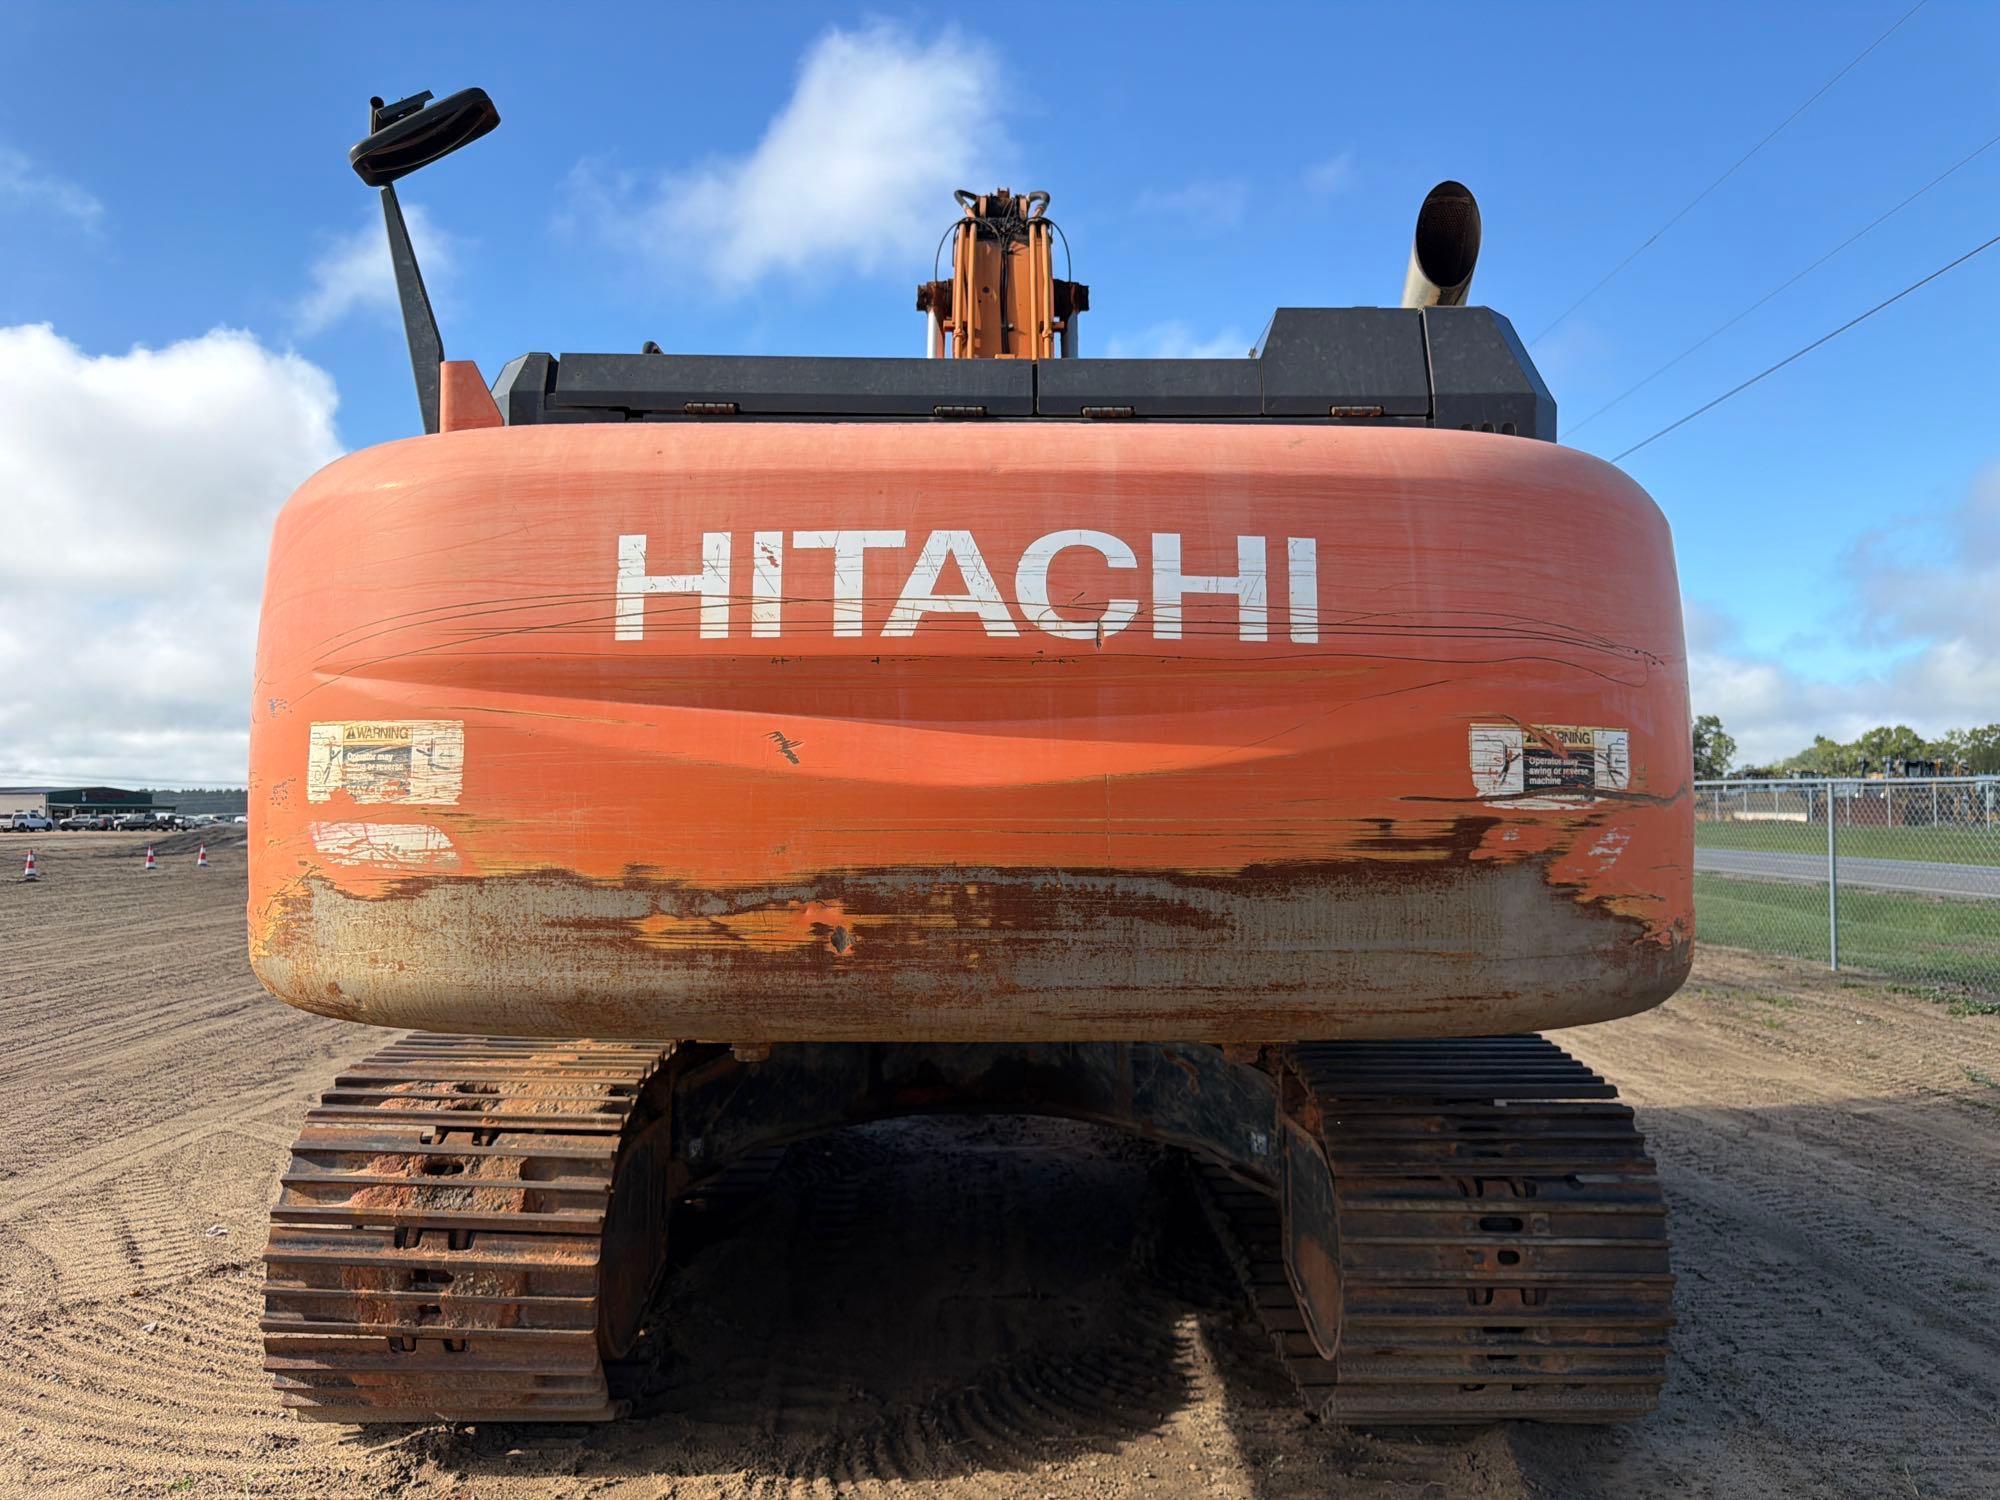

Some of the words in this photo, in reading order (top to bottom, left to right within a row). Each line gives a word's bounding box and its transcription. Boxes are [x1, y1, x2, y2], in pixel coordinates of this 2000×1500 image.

[614, 529, 1319, 644] HITACHI
[357, 726, 409, 740] WARNING
[1539, 731, 1591, 745] RNING
[377, 753, 393, 762] may
[1529, 757, 1562, 766] Operator
[1529, 767, 1552, 777] swing
[1529, 777, 1562, 785] machine
